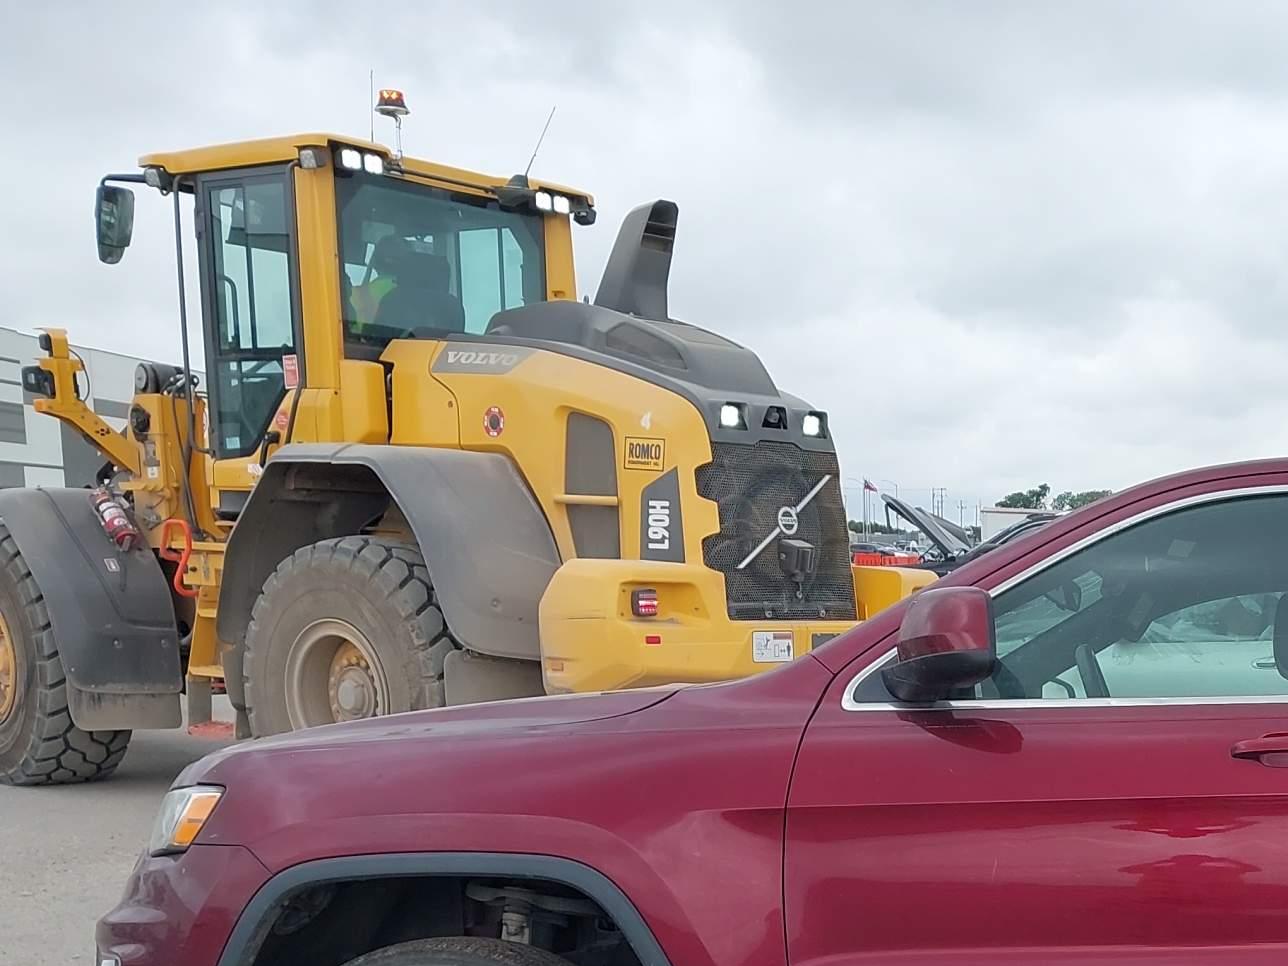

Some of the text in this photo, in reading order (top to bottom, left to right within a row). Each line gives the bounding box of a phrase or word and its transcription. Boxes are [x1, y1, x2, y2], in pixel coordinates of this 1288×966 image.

[448, 351, 518, 366] VOLVO
[628, 442, 661, 460] ROMCO
[648, 500, 670, 550] L90H
